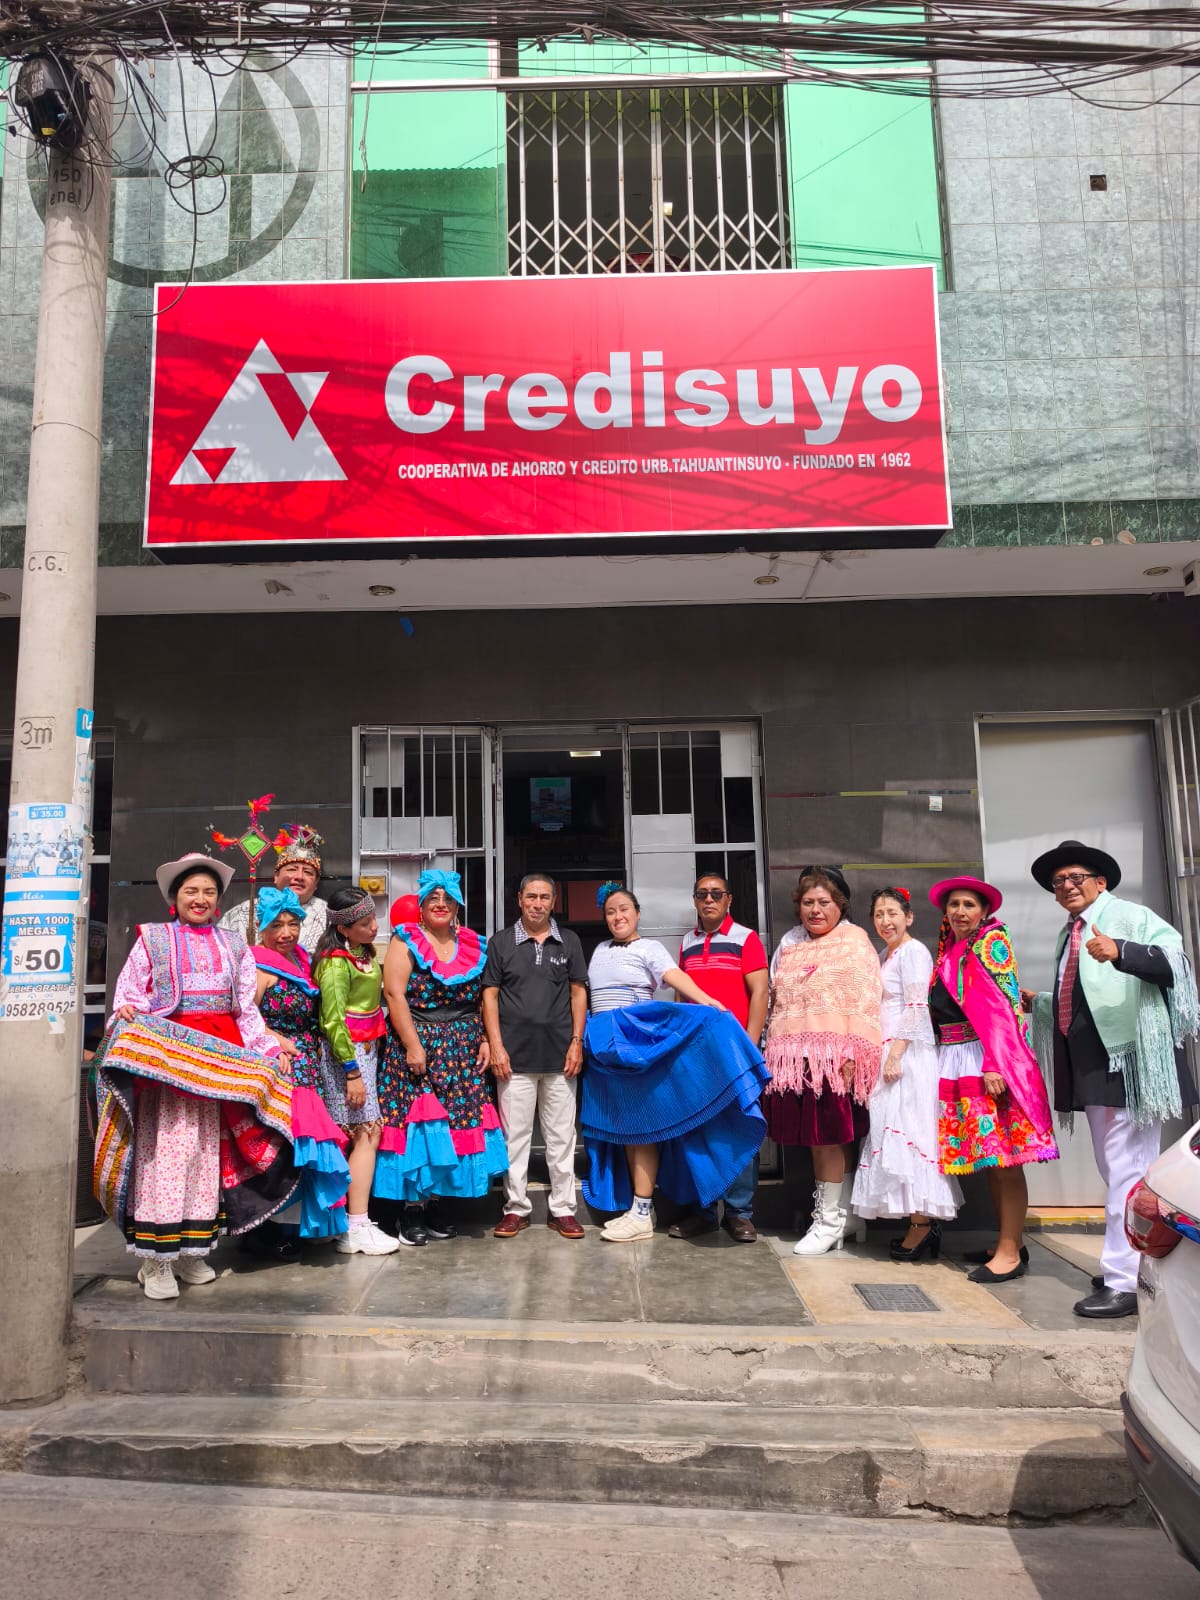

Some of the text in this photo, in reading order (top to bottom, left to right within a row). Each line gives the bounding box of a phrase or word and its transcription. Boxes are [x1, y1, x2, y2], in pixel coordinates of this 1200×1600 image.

[53, 168, 81, 184] 150
[385, 351, 922, 446] Credisuyo
[398, 463, 488, 480] COOPERATIVA
[491, 462, 509, 478] DE
[511, 461, 566, 477] AHORRO
[569, 461, 579, 475] Y
[582, 459, 638, 475] CREDITO
[793, 454, 855, 470] FUNDADO
[858, 453, 876, 468] EN
[880, 452, 912, 468] 1962
[28, 555, 62, 572] C.G.
[20, 720, 53, 745] 3m
[9, 915, 70, 926] HASTA 1000
[18, 927, 57, 936] MEGAS
[14, 949, 61, 971] S/ 50
